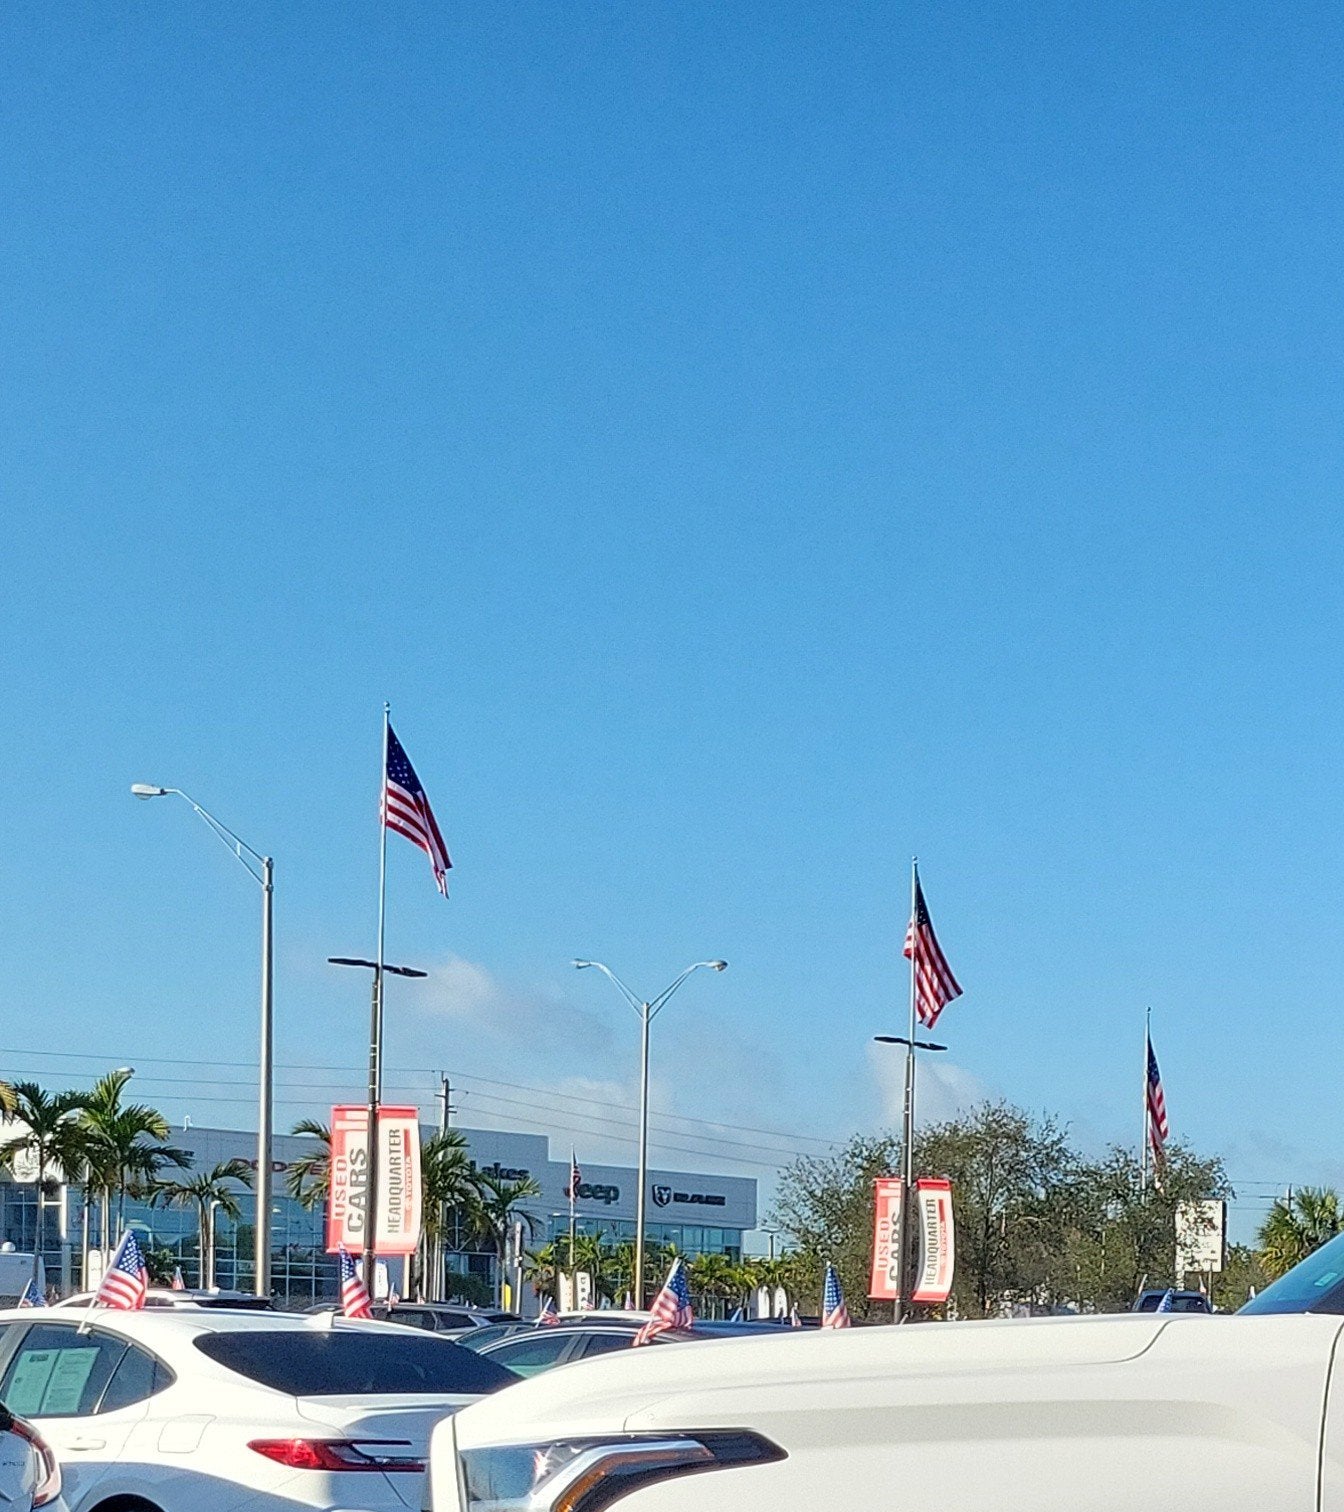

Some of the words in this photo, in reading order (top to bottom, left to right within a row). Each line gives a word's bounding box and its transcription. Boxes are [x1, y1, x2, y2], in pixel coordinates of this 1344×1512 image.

[334, 1158, 347, 1218] USED
[347, 1148, 368, 1232] CARS
[387, 1128, 403, 1235] HEADQUARTER
[879, 1219, 890, 1269] USED
[925, 1198, 940, 1286] HEADQUARTER
